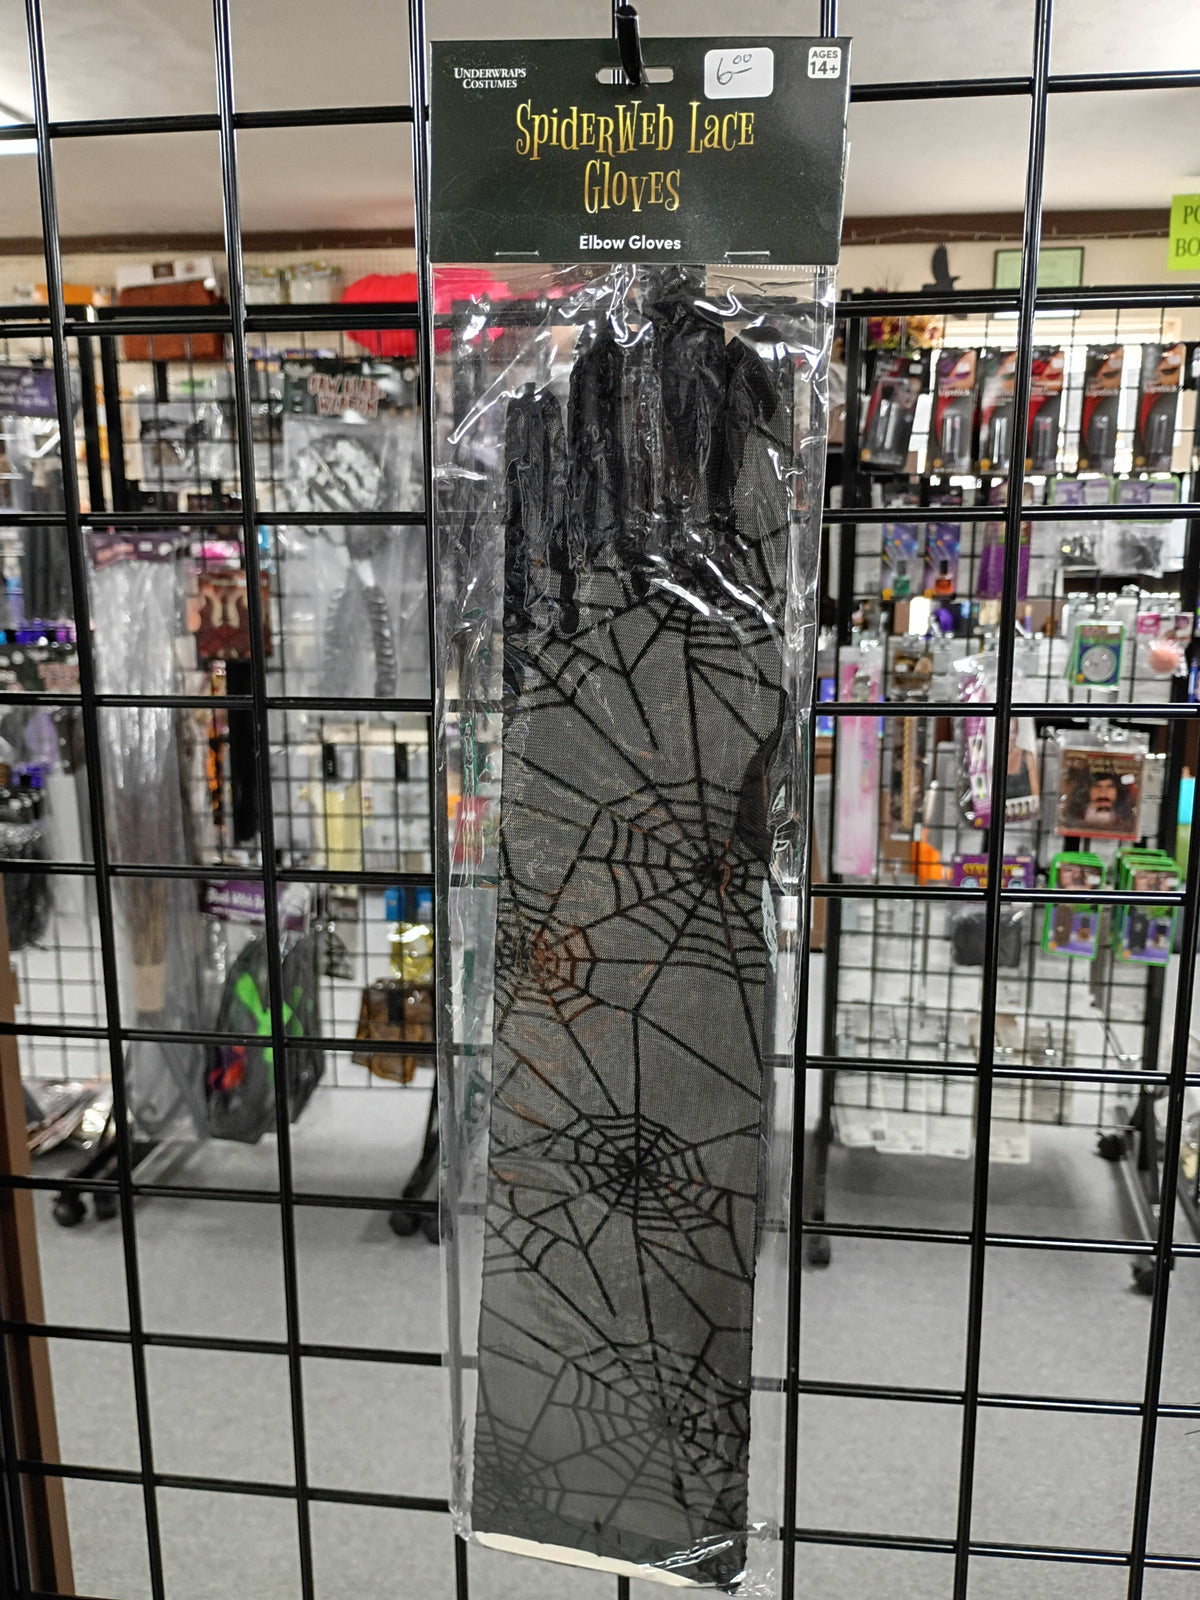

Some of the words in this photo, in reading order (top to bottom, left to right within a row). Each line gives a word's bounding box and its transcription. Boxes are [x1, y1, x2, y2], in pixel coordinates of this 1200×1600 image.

[811, 50, 838, 59] AGES
[454, 67, 527, 79] UNDERWRAPS
[810, 61, 838, 75] 14+
[463, 79, 518, 89] COSTUMES
[579, 235, 625, 250] Elbow
[628, 235, 681, 250] Gloves
